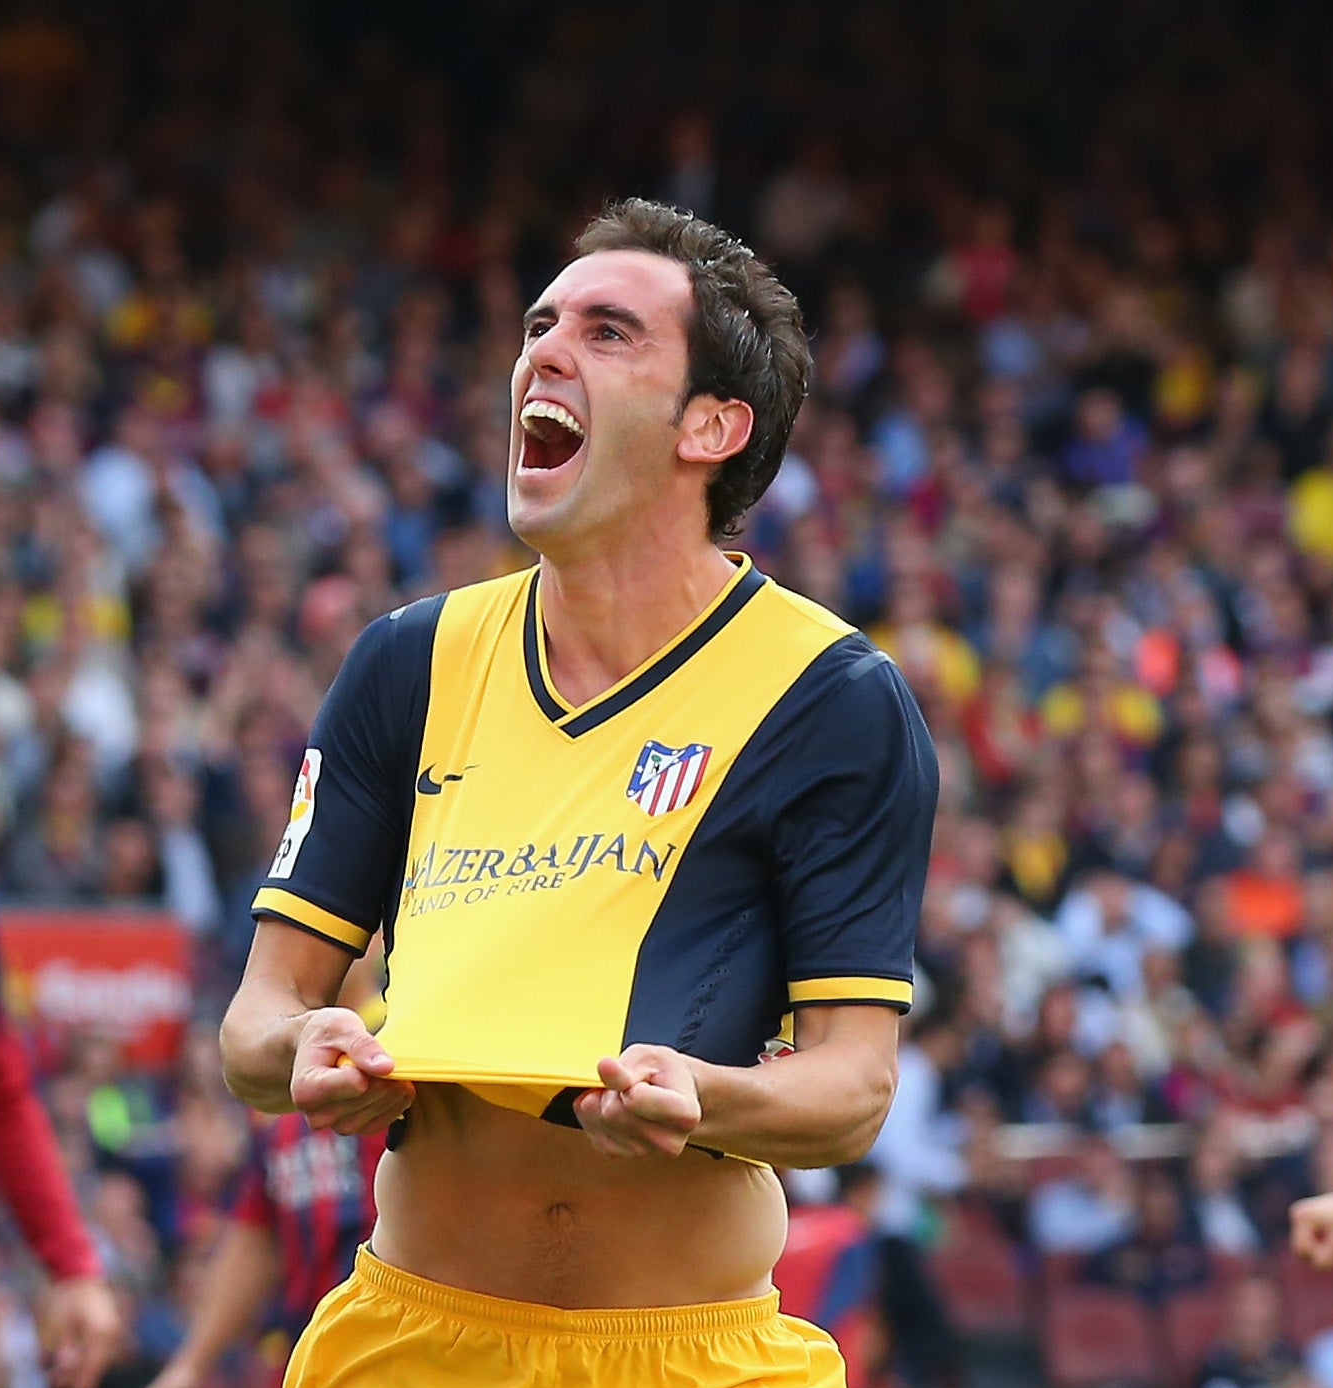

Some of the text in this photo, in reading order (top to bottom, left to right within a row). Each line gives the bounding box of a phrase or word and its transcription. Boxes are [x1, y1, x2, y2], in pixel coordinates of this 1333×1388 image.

[413, 832, 677, 889] AZERBAIJAN
[410, 872, 566, 917] LAND OF FIRE
